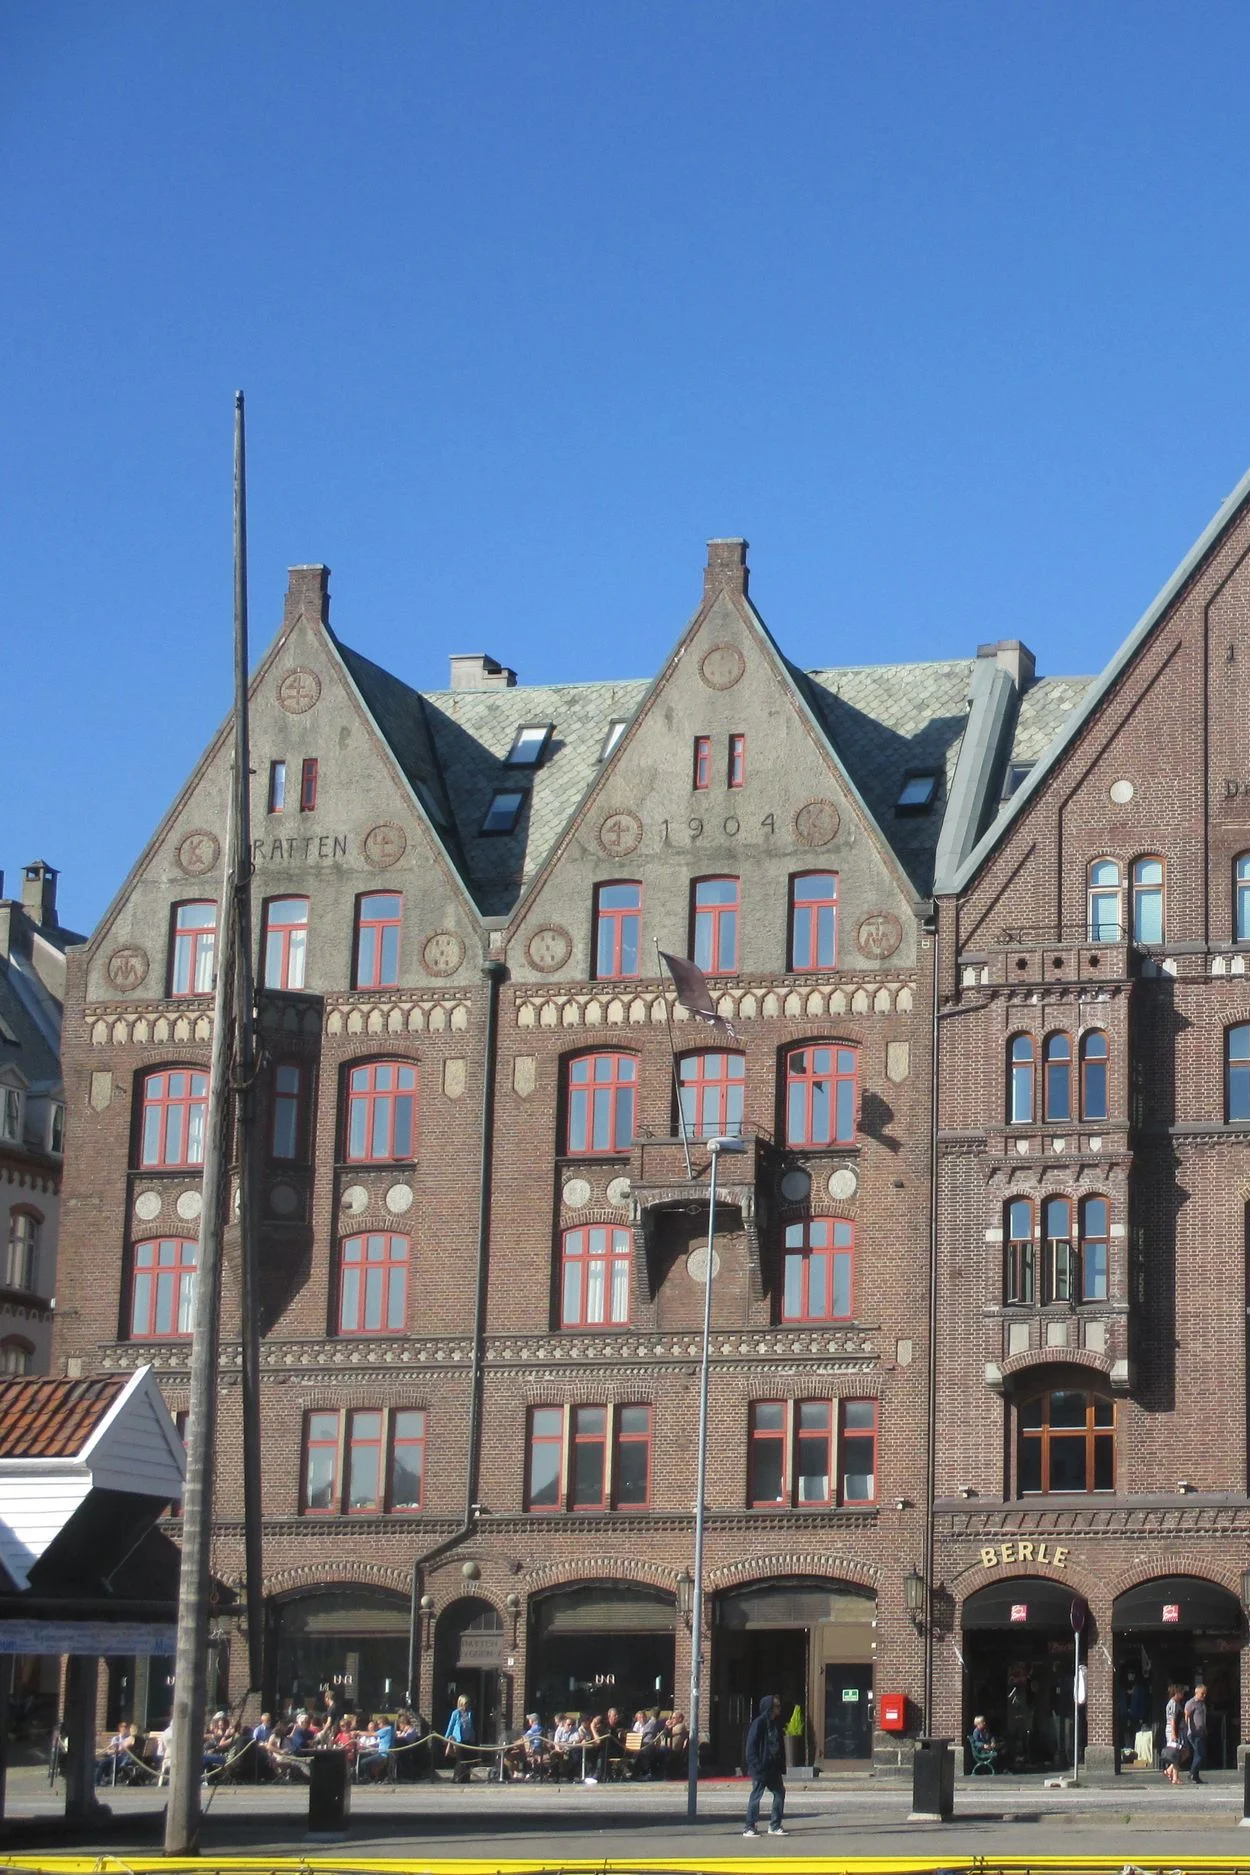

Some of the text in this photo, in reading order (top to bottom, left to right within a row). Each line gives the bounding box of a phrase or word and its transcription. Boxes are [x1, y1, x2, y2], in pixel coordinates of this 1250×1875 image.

[661, 812, 776, 840] 1904
[252, 835, 347, 861] RATTEN
[981, 1541, 1069, 1568] BERLE
